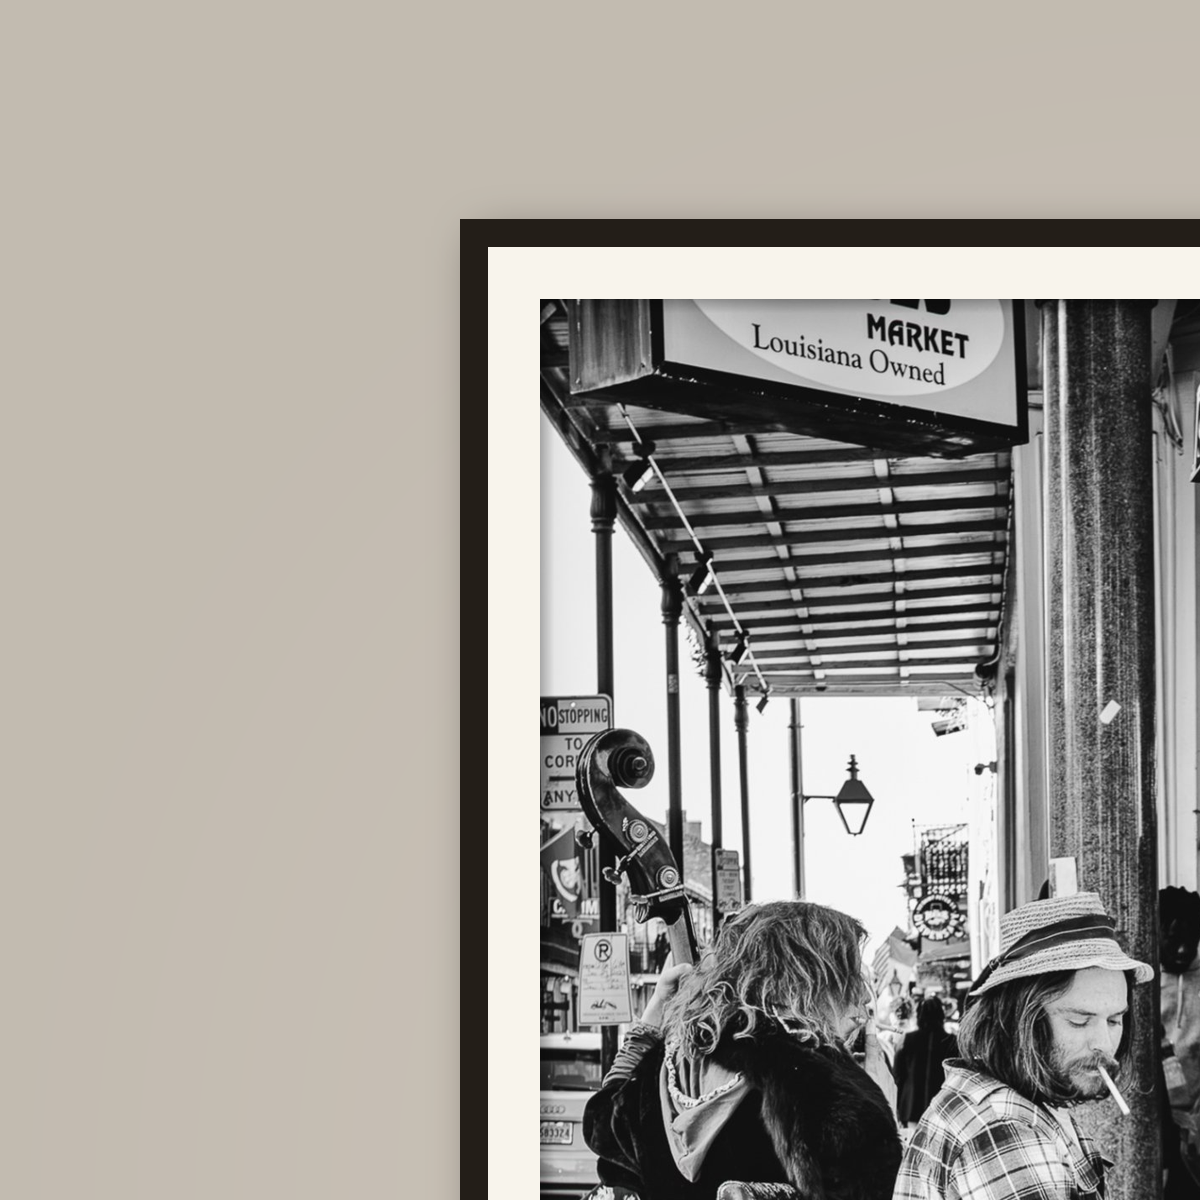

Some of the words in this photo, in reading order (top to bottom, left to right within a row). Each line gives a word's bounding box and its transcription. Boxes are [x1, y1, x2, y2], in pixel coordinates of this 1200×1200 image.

[867, 313, 970, 359] MARKET
[751, 323, 863, 370] Louisiana
[869, 349, 946, 386] Owned
[558, 708, 608, 724] STOPPING
[564, 737, 583, 751] TO
[544, 755, 579, 769] COR
[543, 789, 578, 804] ANY
